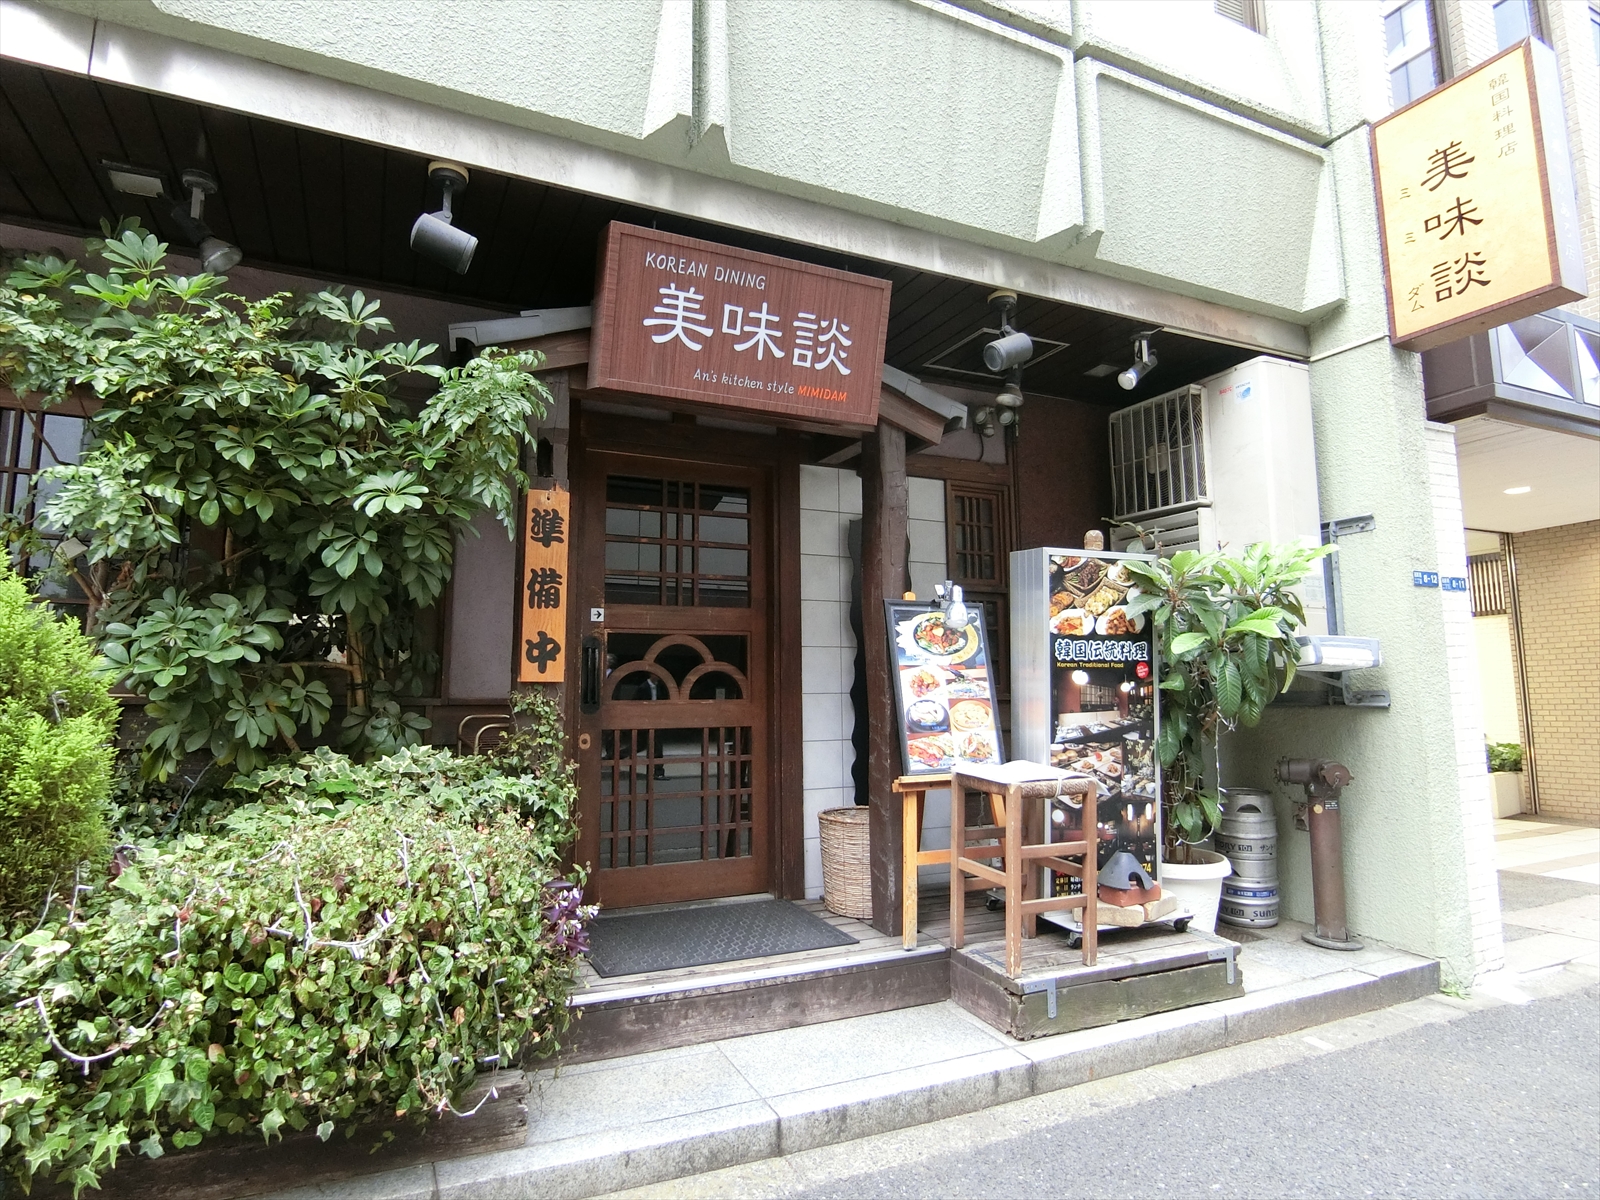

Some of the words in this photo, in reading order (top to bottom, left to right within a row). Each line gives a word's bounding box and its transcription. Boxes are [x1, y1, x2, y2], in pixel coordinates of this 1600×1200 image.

[1488, 72, 1518, 158] 韓国料理店
[1420, 140, 1492, 303] 美味談
[645, 251, 708, 278] KOREAN
[714, 266, 766, 290] DINING
[642, 282, 853, 376] 美味談
[693, 368, 718, 383] An's
[721, 372, 763, 390] kitchen
[766, 380, 795, 395] style
[797, 385, 848, 403] MIMIDAM
[525, 507, 565, 674] 準備中
[1055, 638, 1148, 661] 韓国伝統料理
